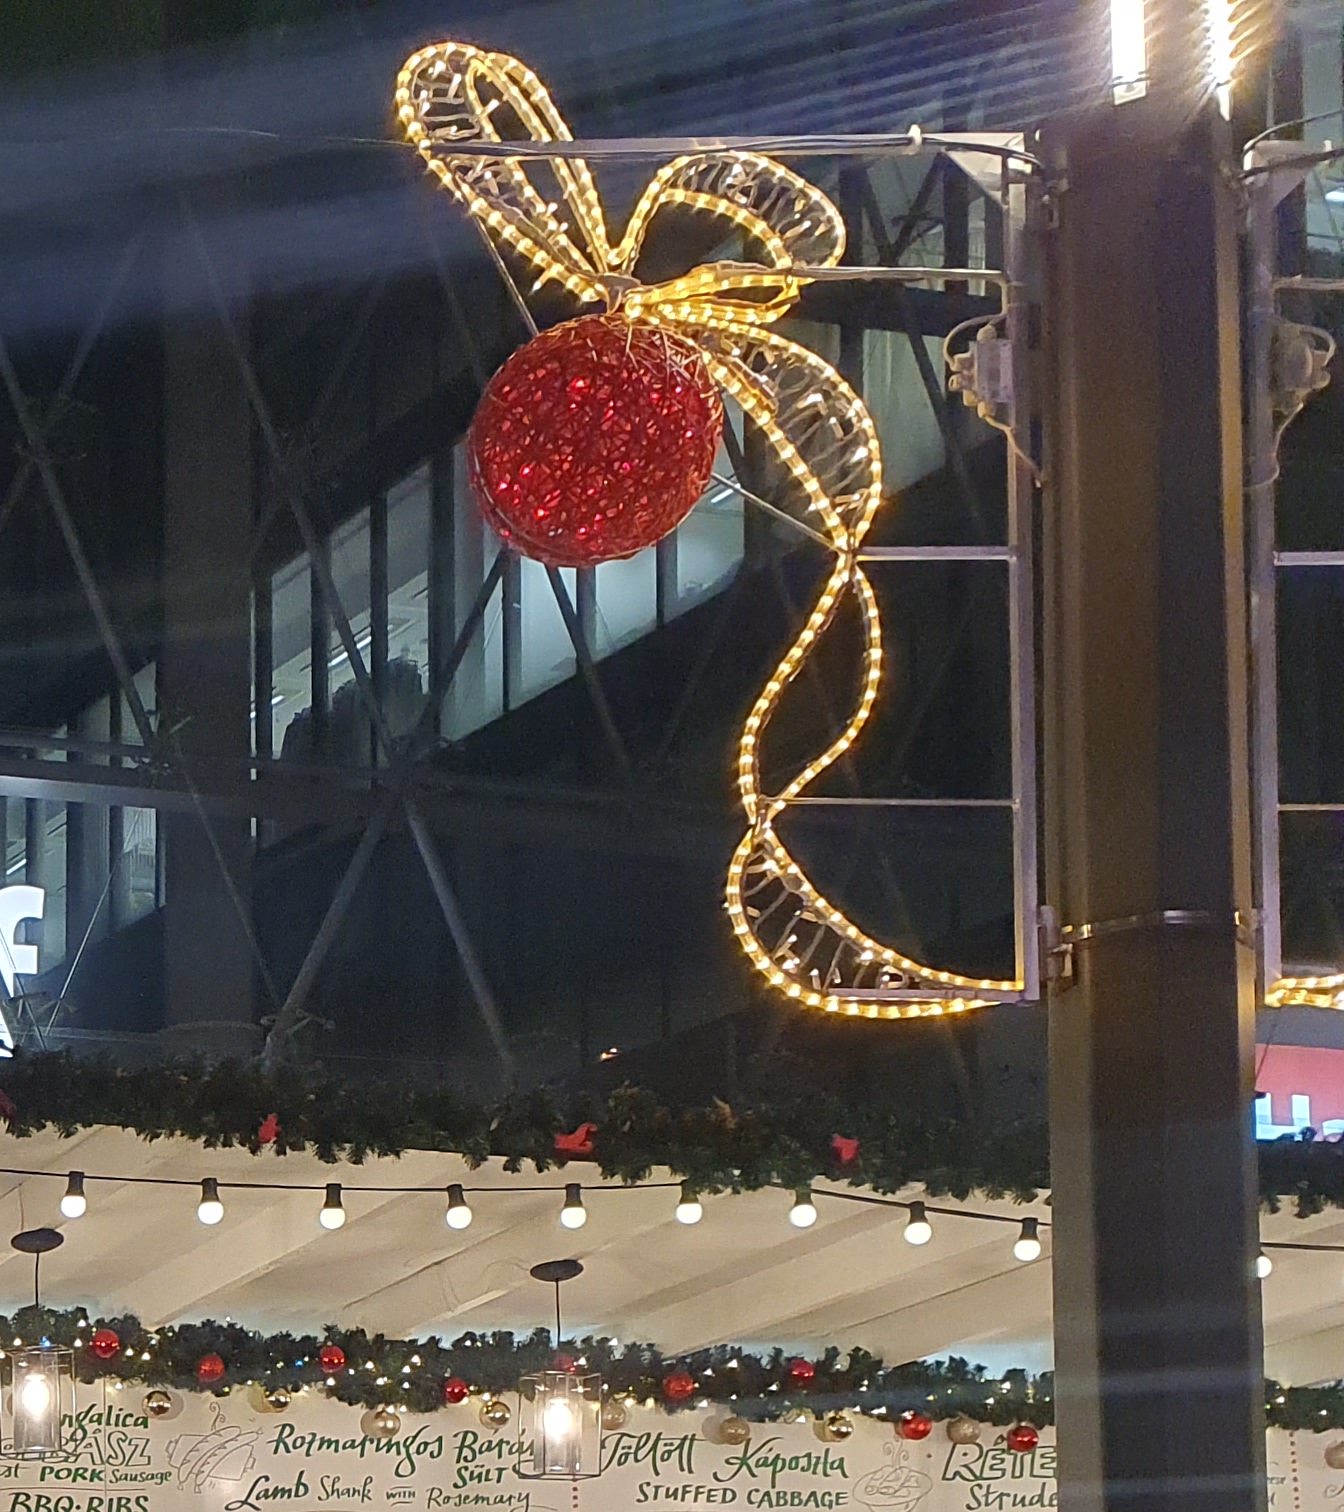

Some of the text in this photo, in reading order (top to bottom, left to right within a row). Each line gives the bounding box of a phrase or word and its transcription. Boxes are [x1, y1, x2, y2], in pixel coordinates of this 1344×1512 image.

[61, 1403, 149, 1442] ngalica
[601, 1432, 850, 1488] Töltött Káposzta
[941, 1434, 1056, 1482] RÉTE
[40, 1466, 105, 1483] PORK
[109, 1469, 173, 1486] Sausage
[225, 1470, 309, 1512] Lamb
[317, 1475, 373, 1503] Shank
[453, 1464, 508, 1489] SÜLT
[636, 1482, 849, 1510] STUFFED CABBAGE
[966, 1482, 1058, 1511] Strude
